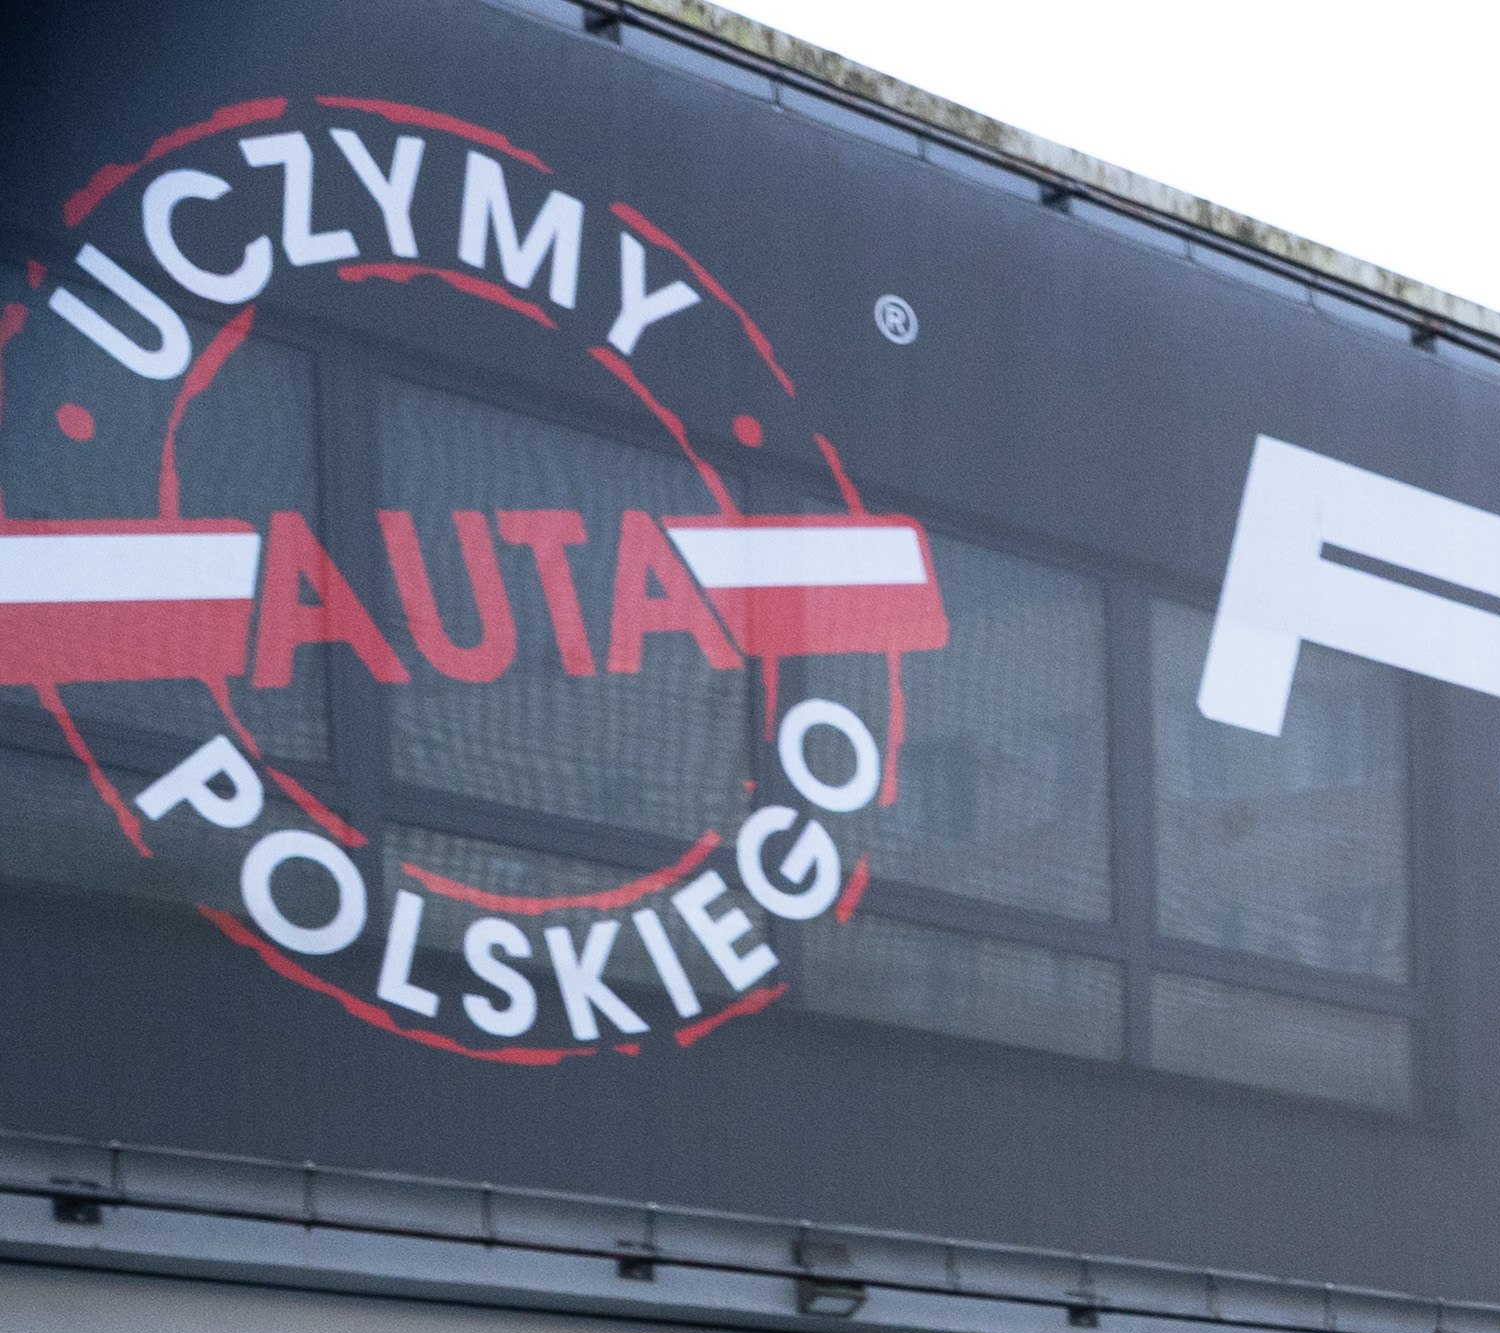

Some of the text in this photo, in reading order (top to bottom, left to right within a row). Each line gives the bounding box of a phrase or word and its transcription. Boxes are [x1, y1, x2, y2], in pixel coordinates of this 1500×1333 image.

[50, 128, 700, 381] UCZYMY
[252, 509, 743, 689] AUTA
[135, 697, 882, 1040] POLSKIEGO
